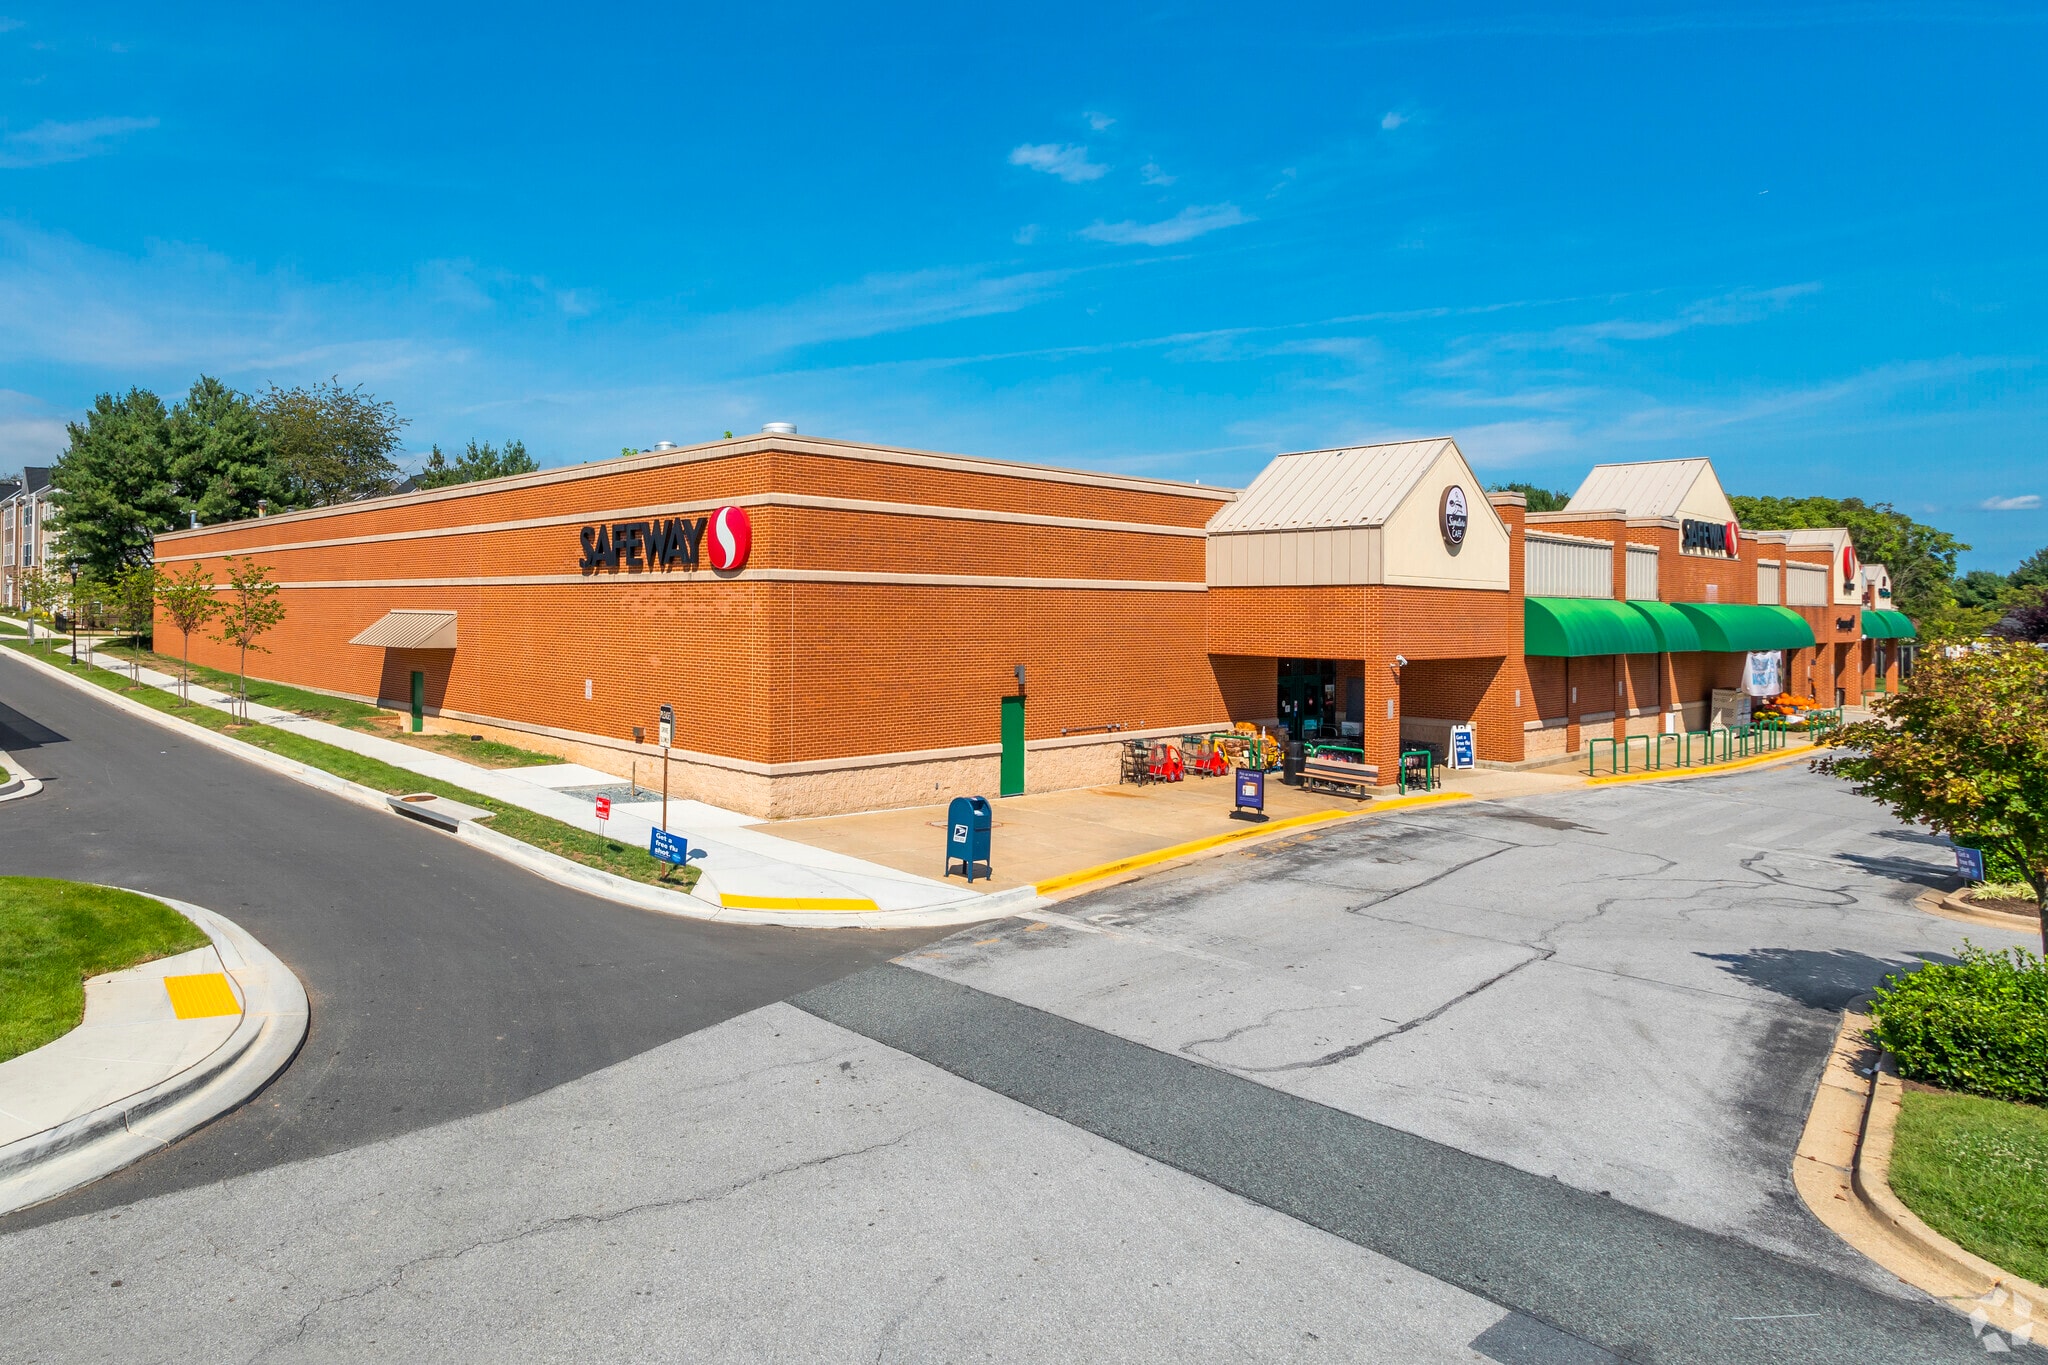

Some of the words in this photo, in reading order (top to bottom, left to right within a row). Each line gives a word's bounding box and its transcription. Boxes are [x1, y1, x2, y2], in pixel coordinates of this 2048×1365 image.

[579, 517, 708, 569] SAFEWAY
[656, 832, 667, 842] Get
[655, 839, 668, 849] free
[669, 844, 679, 853] flu
